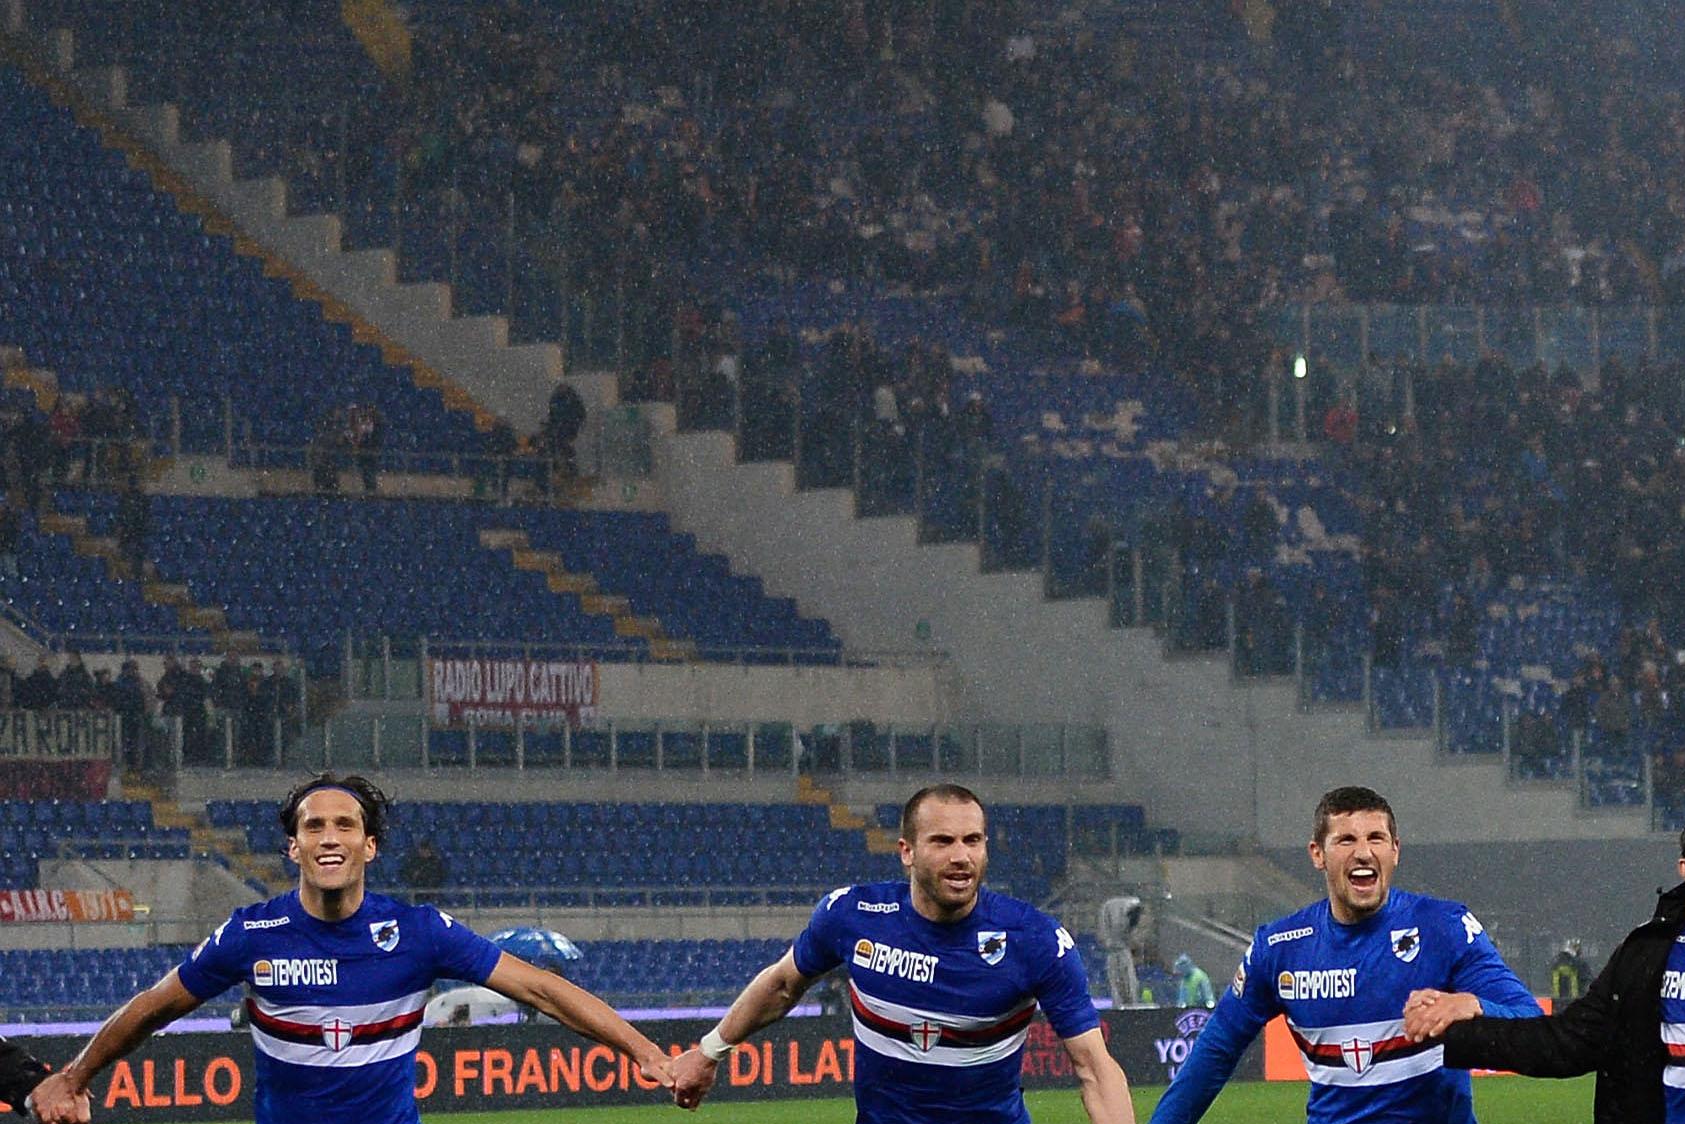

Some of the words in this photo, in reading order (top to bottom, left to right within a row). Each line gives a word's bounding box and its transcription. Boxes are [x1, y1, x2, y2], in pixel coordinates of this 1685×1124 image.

[433, 659, 482, 702] RADIO
[486, 660, 525, 704] LUPO
[529, 661, 593, 705] CATTIVO
[271, 958, 339, 986] TEMPOTEST
[870, 942, 939, 984] TEMPOTEST
[1293, 968, 1357, 1000] TEMPOTEST
[104, 1056, 242, 1109] ALLO
[454, 1040, 699, 1097] FRANCI
[729, 1040, 773, 1087] DI
